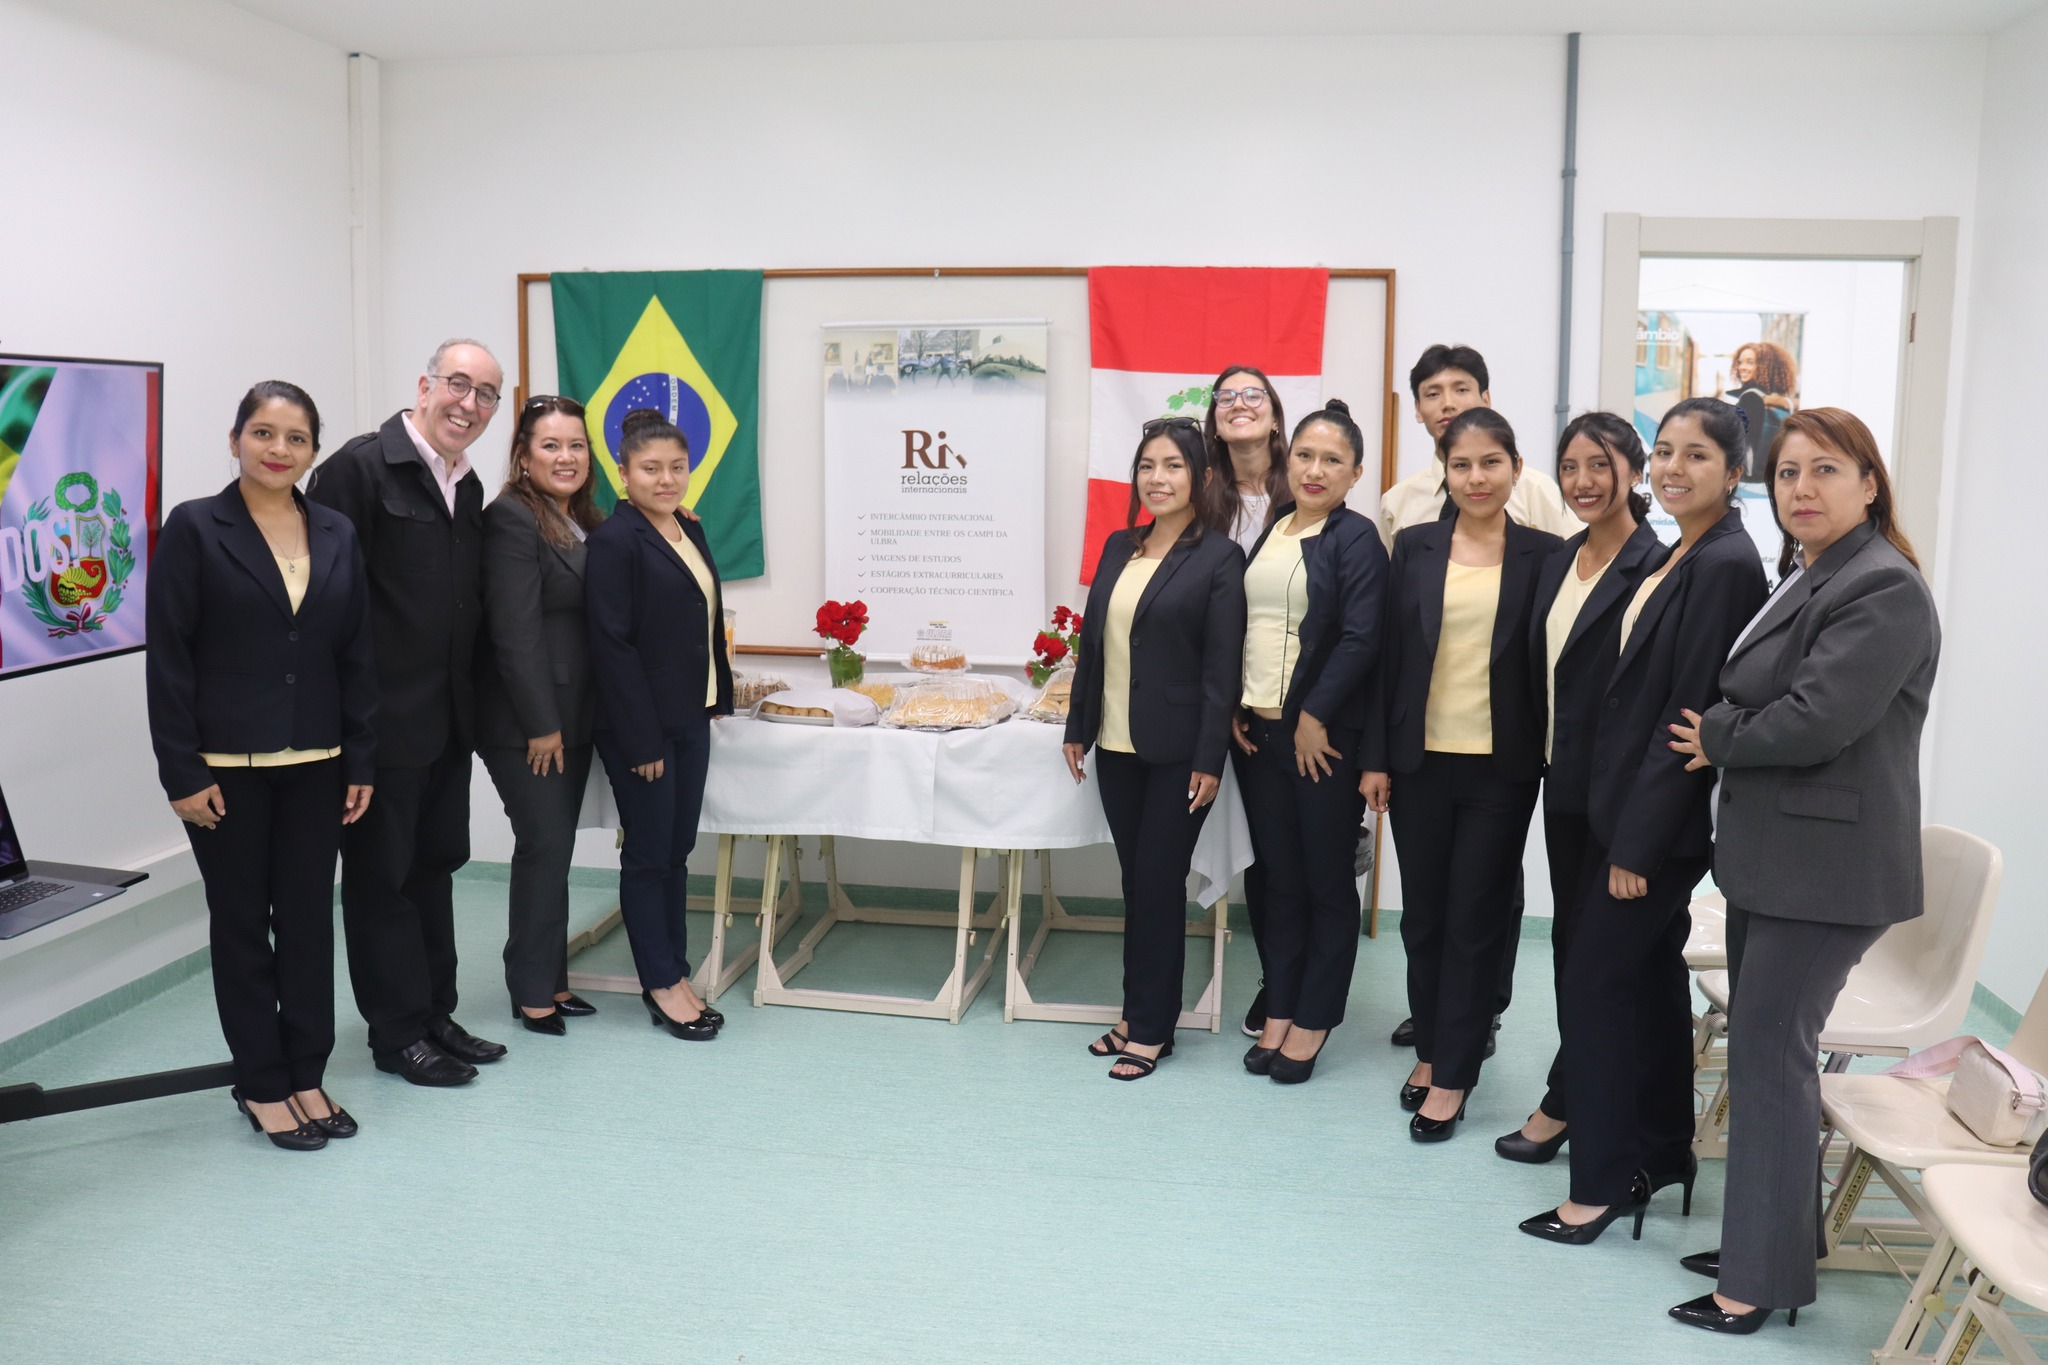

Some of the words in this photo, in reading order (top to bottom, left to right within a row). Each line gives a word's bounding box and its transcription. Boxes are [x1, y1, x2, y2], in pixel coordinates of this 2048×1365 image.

[901, 430, 967, 469] Ri
[901, 471, 967, 486] relações
[901, 486, 967, 494] internacionais
[871, 512, 927, 521] INTERCÂMBIO
[929, 513, 995, 522] INTERNACIONAL
[871, 529, 922, 537] MOBILIDADE
[924, 530, 951, 538] ENTRE
[953, 530, 966, 538] OS
[967, 530, 994, 538] CAMPI
[871, 538, 898, 546] ULBRA
[871, 554, 907, 562] VIAGENS
[922, 555, 962, 563] ESTUDOS
[871, 569, 911, 578] ESTÁGIOS
[913, 571, 1004, 580] EXTRACURRICULARES
[871, 586, 926, 596] COOPERAÇÃO
